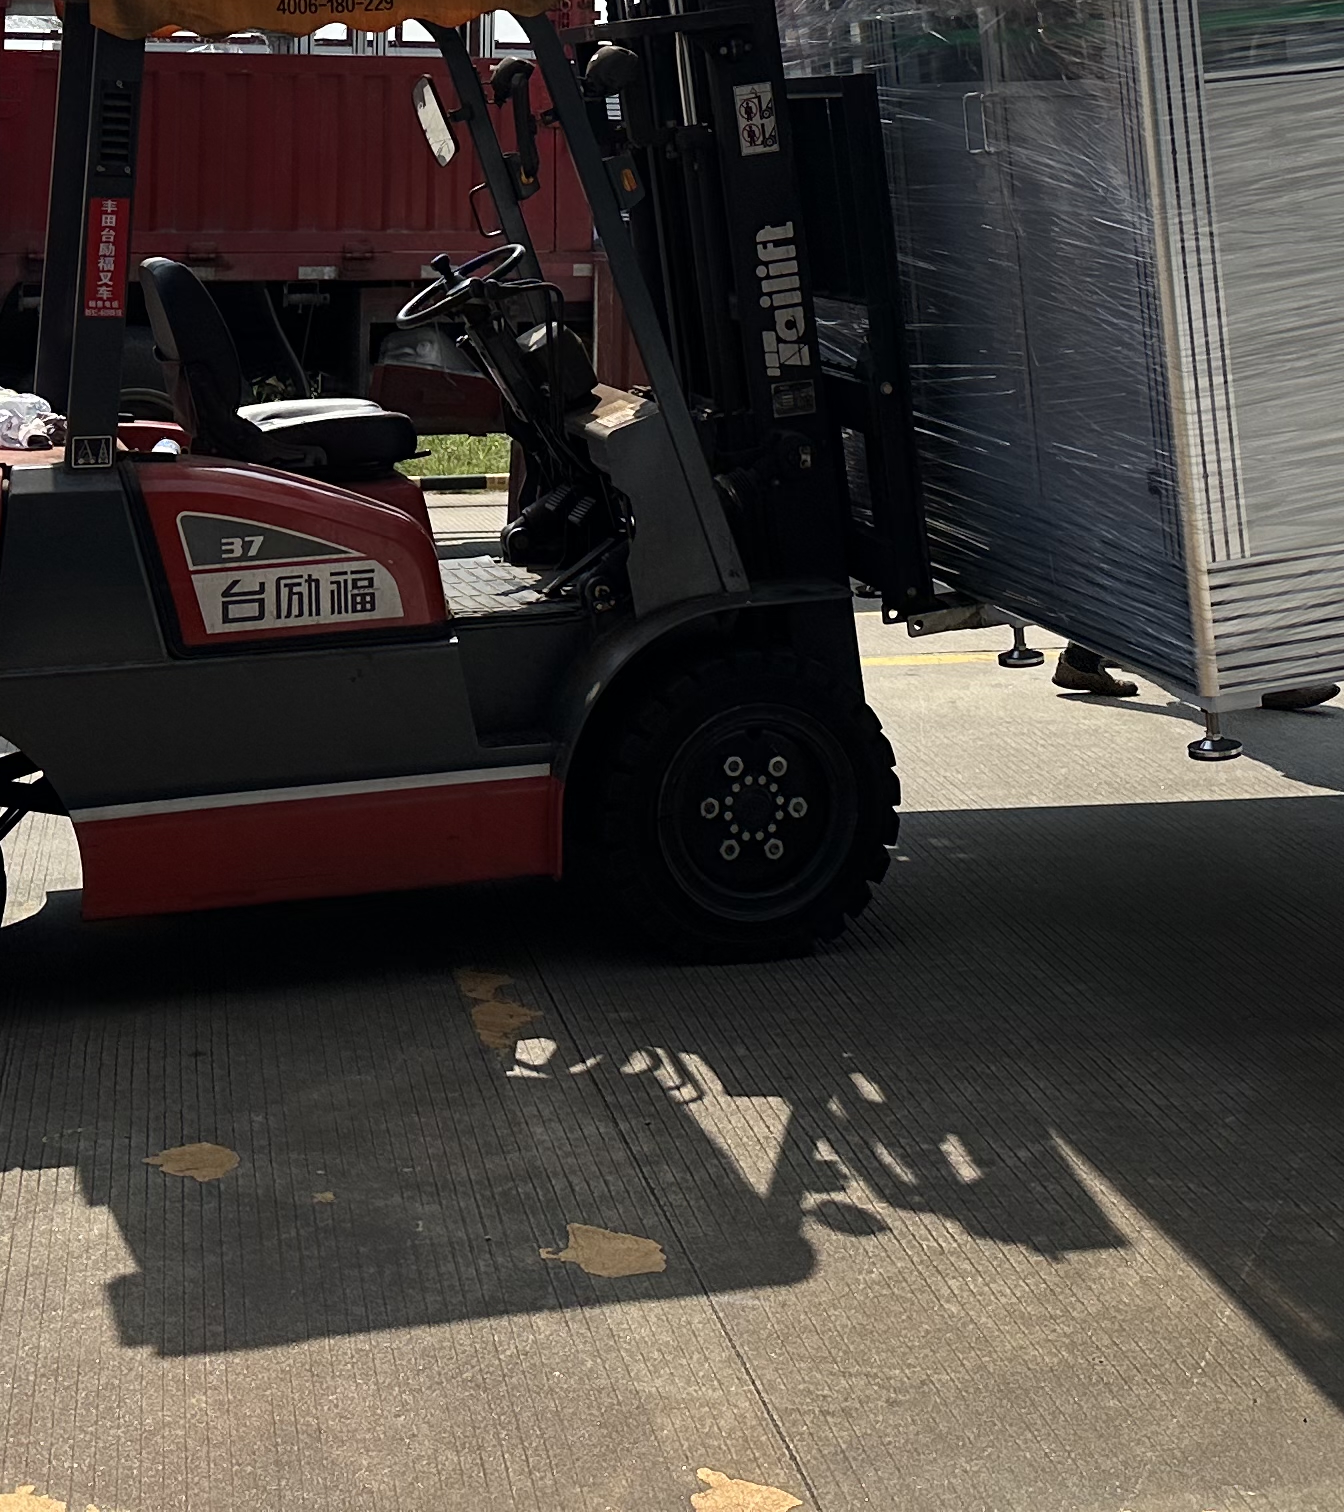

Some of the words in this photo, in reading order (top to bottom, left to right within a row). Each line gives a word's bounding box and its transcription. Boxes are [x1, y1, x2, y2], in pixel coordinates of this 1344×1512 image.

[96, 199, 117, 300] 丰田台励福叉车
[756, 221, 811, 377] Tailift
[221, 535, 264, 558] 37
[221, 568, 376, 624] 台励福
